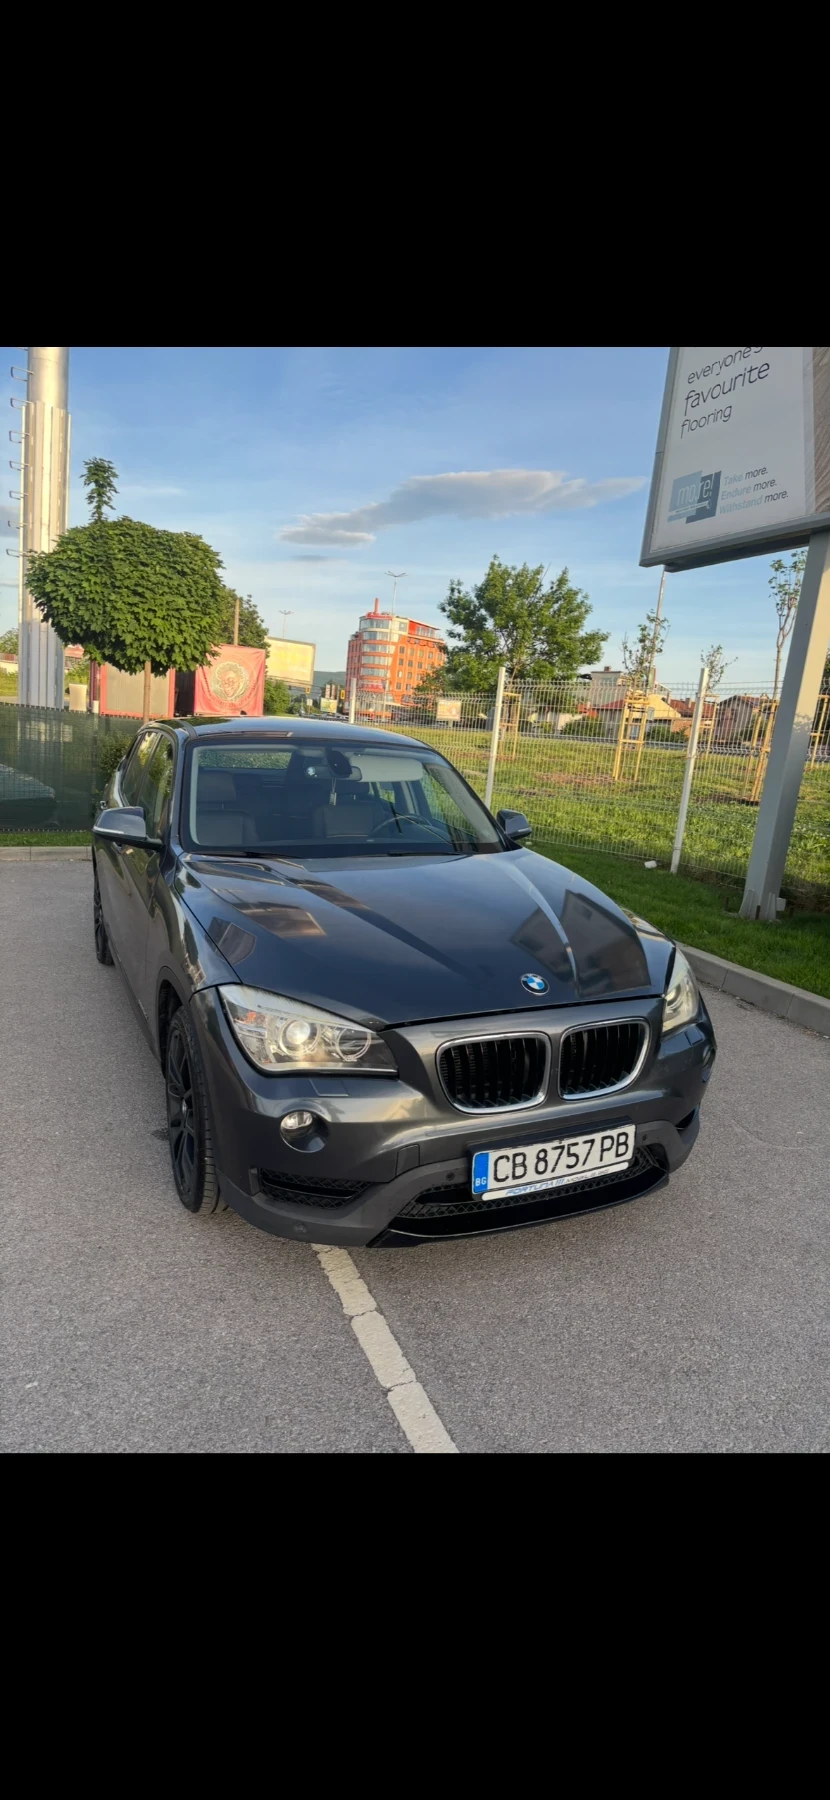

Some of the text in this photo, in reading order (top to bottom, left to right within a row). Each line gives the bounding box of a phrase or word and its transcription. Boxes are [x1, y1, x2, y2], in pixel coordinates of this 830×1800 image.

[684, 362, 770, 416] favourite
[680, 405, 733, 439] flooring
[723, 466, 769, 487] Take more.
[721, 478, 778, 500] Endure more.
[720, 495, 764, 514] Withstand
[764, 490, 789, 504] more.
[493, 1131, 629, 1183] CB 8757 PB
[475, 1177, 487, 1187] BG
[505, 1181, 554, 1196] FORTUNA
